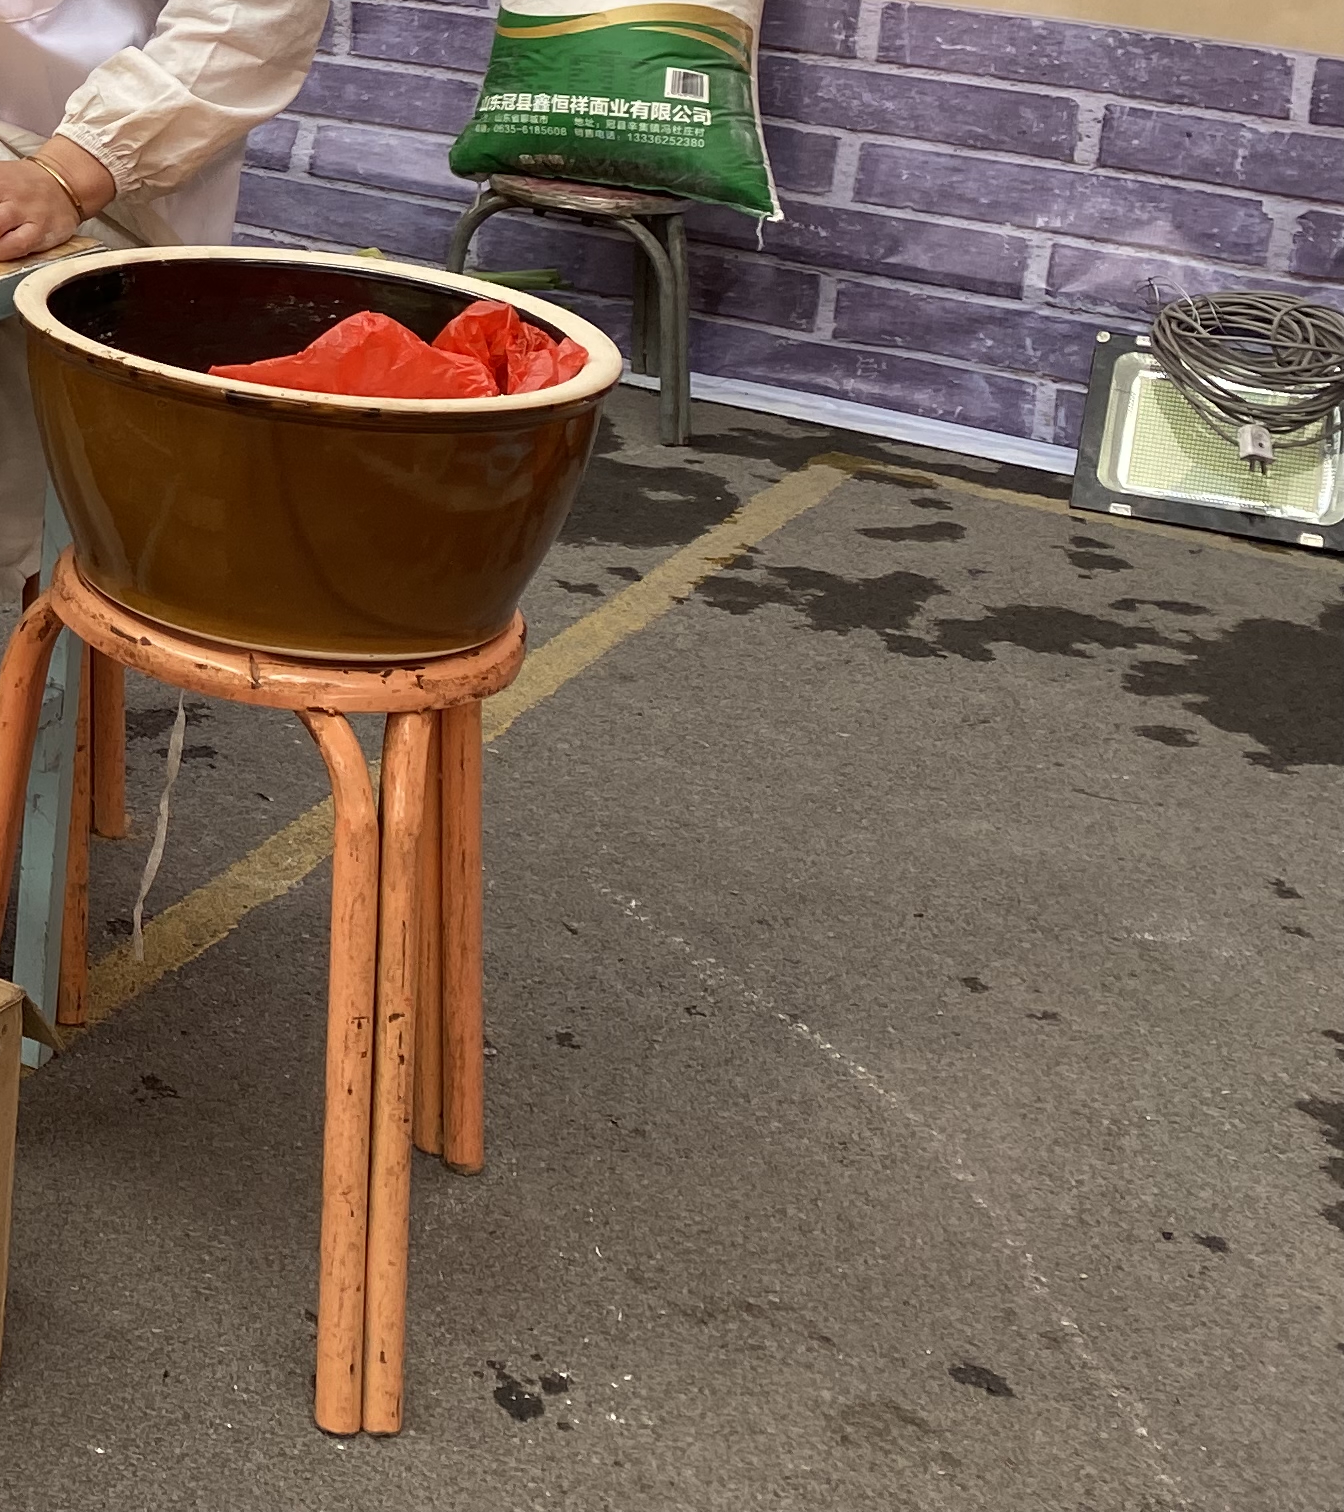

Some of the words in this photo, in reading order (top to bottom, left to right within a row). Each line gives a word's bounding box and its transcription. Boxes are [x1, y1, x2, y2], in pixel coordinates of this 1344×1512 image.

[479, 92, 712, 126] 山东冠县鑫恒祥面业有限公司
